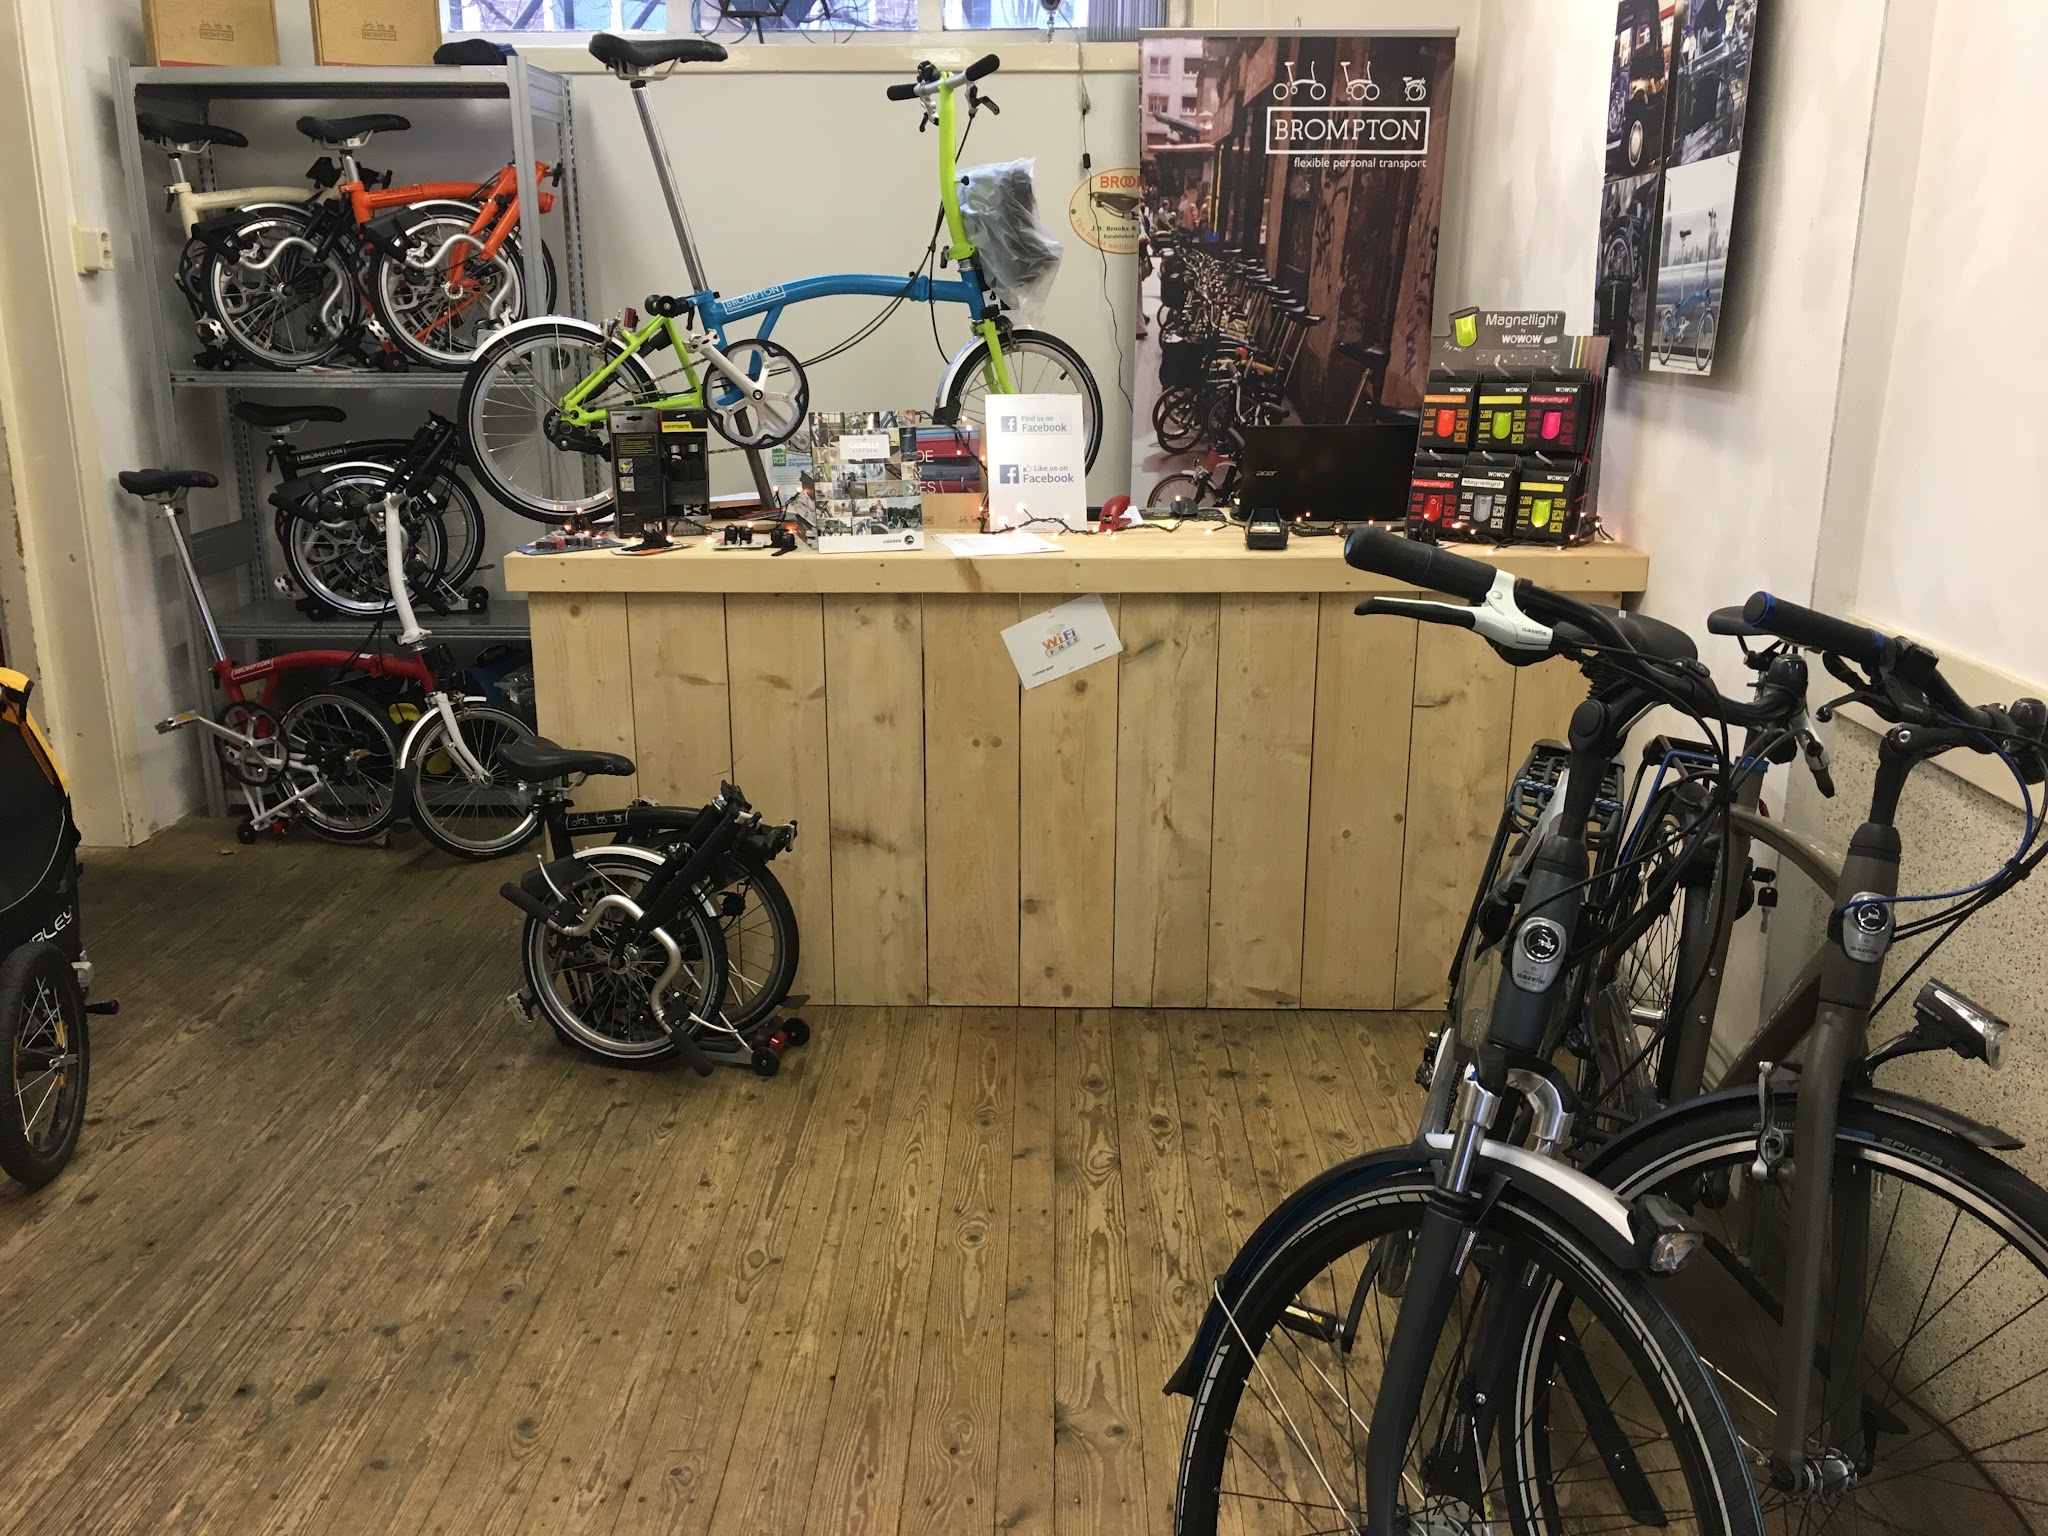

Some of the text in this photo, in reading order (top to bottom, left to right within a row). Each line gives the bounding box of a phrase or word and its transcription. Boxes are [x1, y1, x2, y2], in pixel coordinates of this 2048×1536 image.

[1275, 118, 1421, 141] BROMPTON
[1294, 157, 1427, 171] flexible personal transport
[726, 285, 780, 308] BROMPTON
[1485, 313, 1559, 328] Magnetlight
[1501, 334, 1542, 344] WOWOW
[1530, 395, 1569, 404] Magnetlight
[1022, 423, 1067, 432] Facebook
[300, 448, 343, 461] BROMPTON
[1023, 473, 1074, 483] Facebook
[1411, 480, 1451, 488] Magnetlight
[1463, 479, 1501, 487] Magnetlight
[1041, 628, 1076, 650] WiFi
[1050, 637, 1078, 655] FREE
[233, 659, 271, 675] BROMPTON
[1881, 1137, 1943, 1166] SPICER
